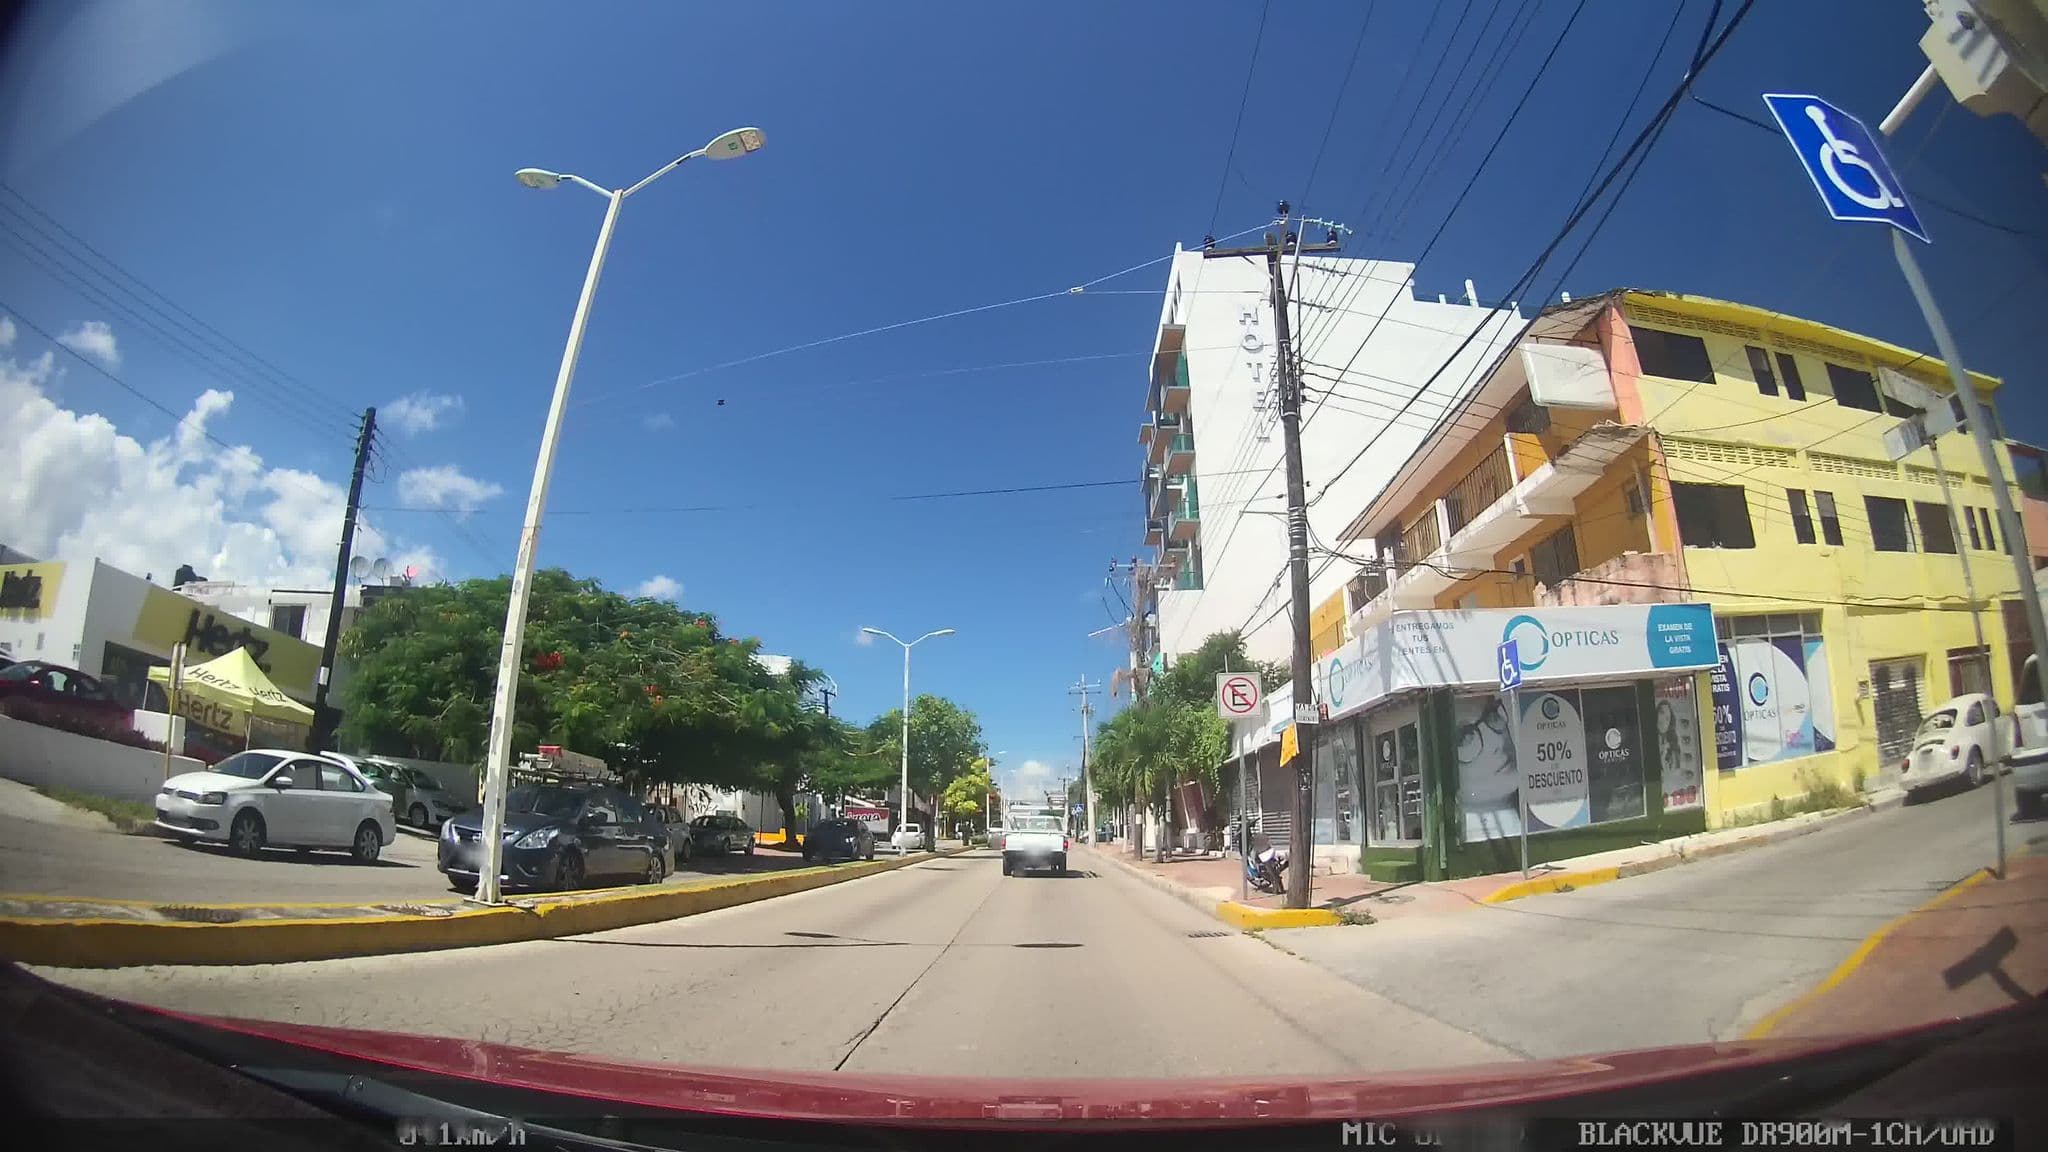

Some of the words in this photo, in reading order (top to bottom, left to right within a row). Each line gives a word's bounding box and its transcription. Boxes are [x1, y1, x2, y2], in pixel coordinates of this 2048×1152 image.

[1395, 622, 1454, 633] ENTREGAMOS
[1657, 623, 1682, 632] EXAMEN
[1683, 622, 1693, 630] DE
[1412, 633, 1429, 642] TUS
[1551, 630, 1619, 648] OPTICAS
[1664, 634, 1674, 643] LA
[1402, 646, 1432, 656] ENTES
[1669, 645, 1692, 654] GRATIS
[188, 668, 241, 690] Hertz
[1712, 683, 1731, 693] RATIS
[1232, 684, 1251, 706] E
[178, 694, 233, 730] Hertz
[1744, 709, 1777, 722] OPTICAS
[1536, 721, 1567, 731] OPTICAS
[1536, 741, 1572, 762] 50%
[1598, 749, 1630, 760] OPTICAS
[1528, 769, 1583, 790] DESCUENTO
